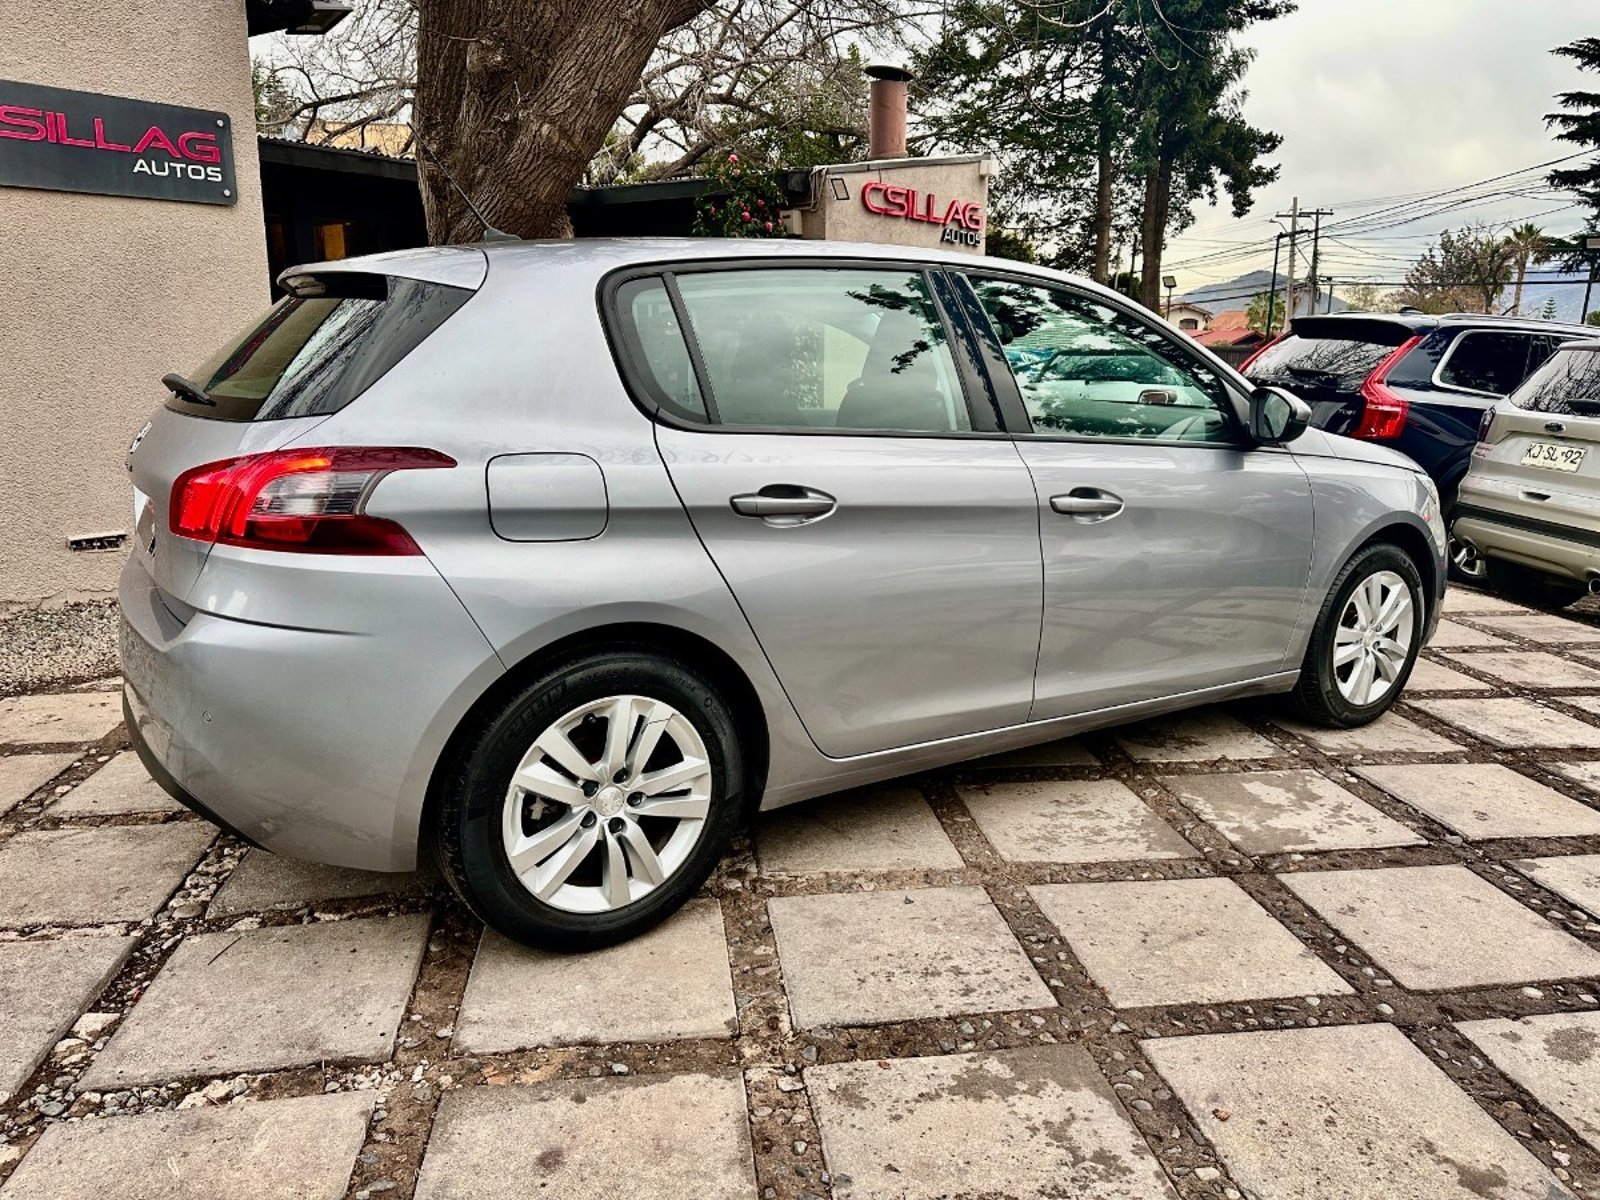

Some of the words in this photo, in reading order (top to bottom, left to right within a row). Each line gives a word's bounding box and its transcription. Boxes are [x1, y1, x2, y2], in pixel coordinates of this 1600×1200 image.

[0, 105, 221, 164] SILLAG
[133, 158, 222, 182] AUTOS
[861, 181, 983, 231] CSILLAG
[942, 228, 981, 246] AUTOS
